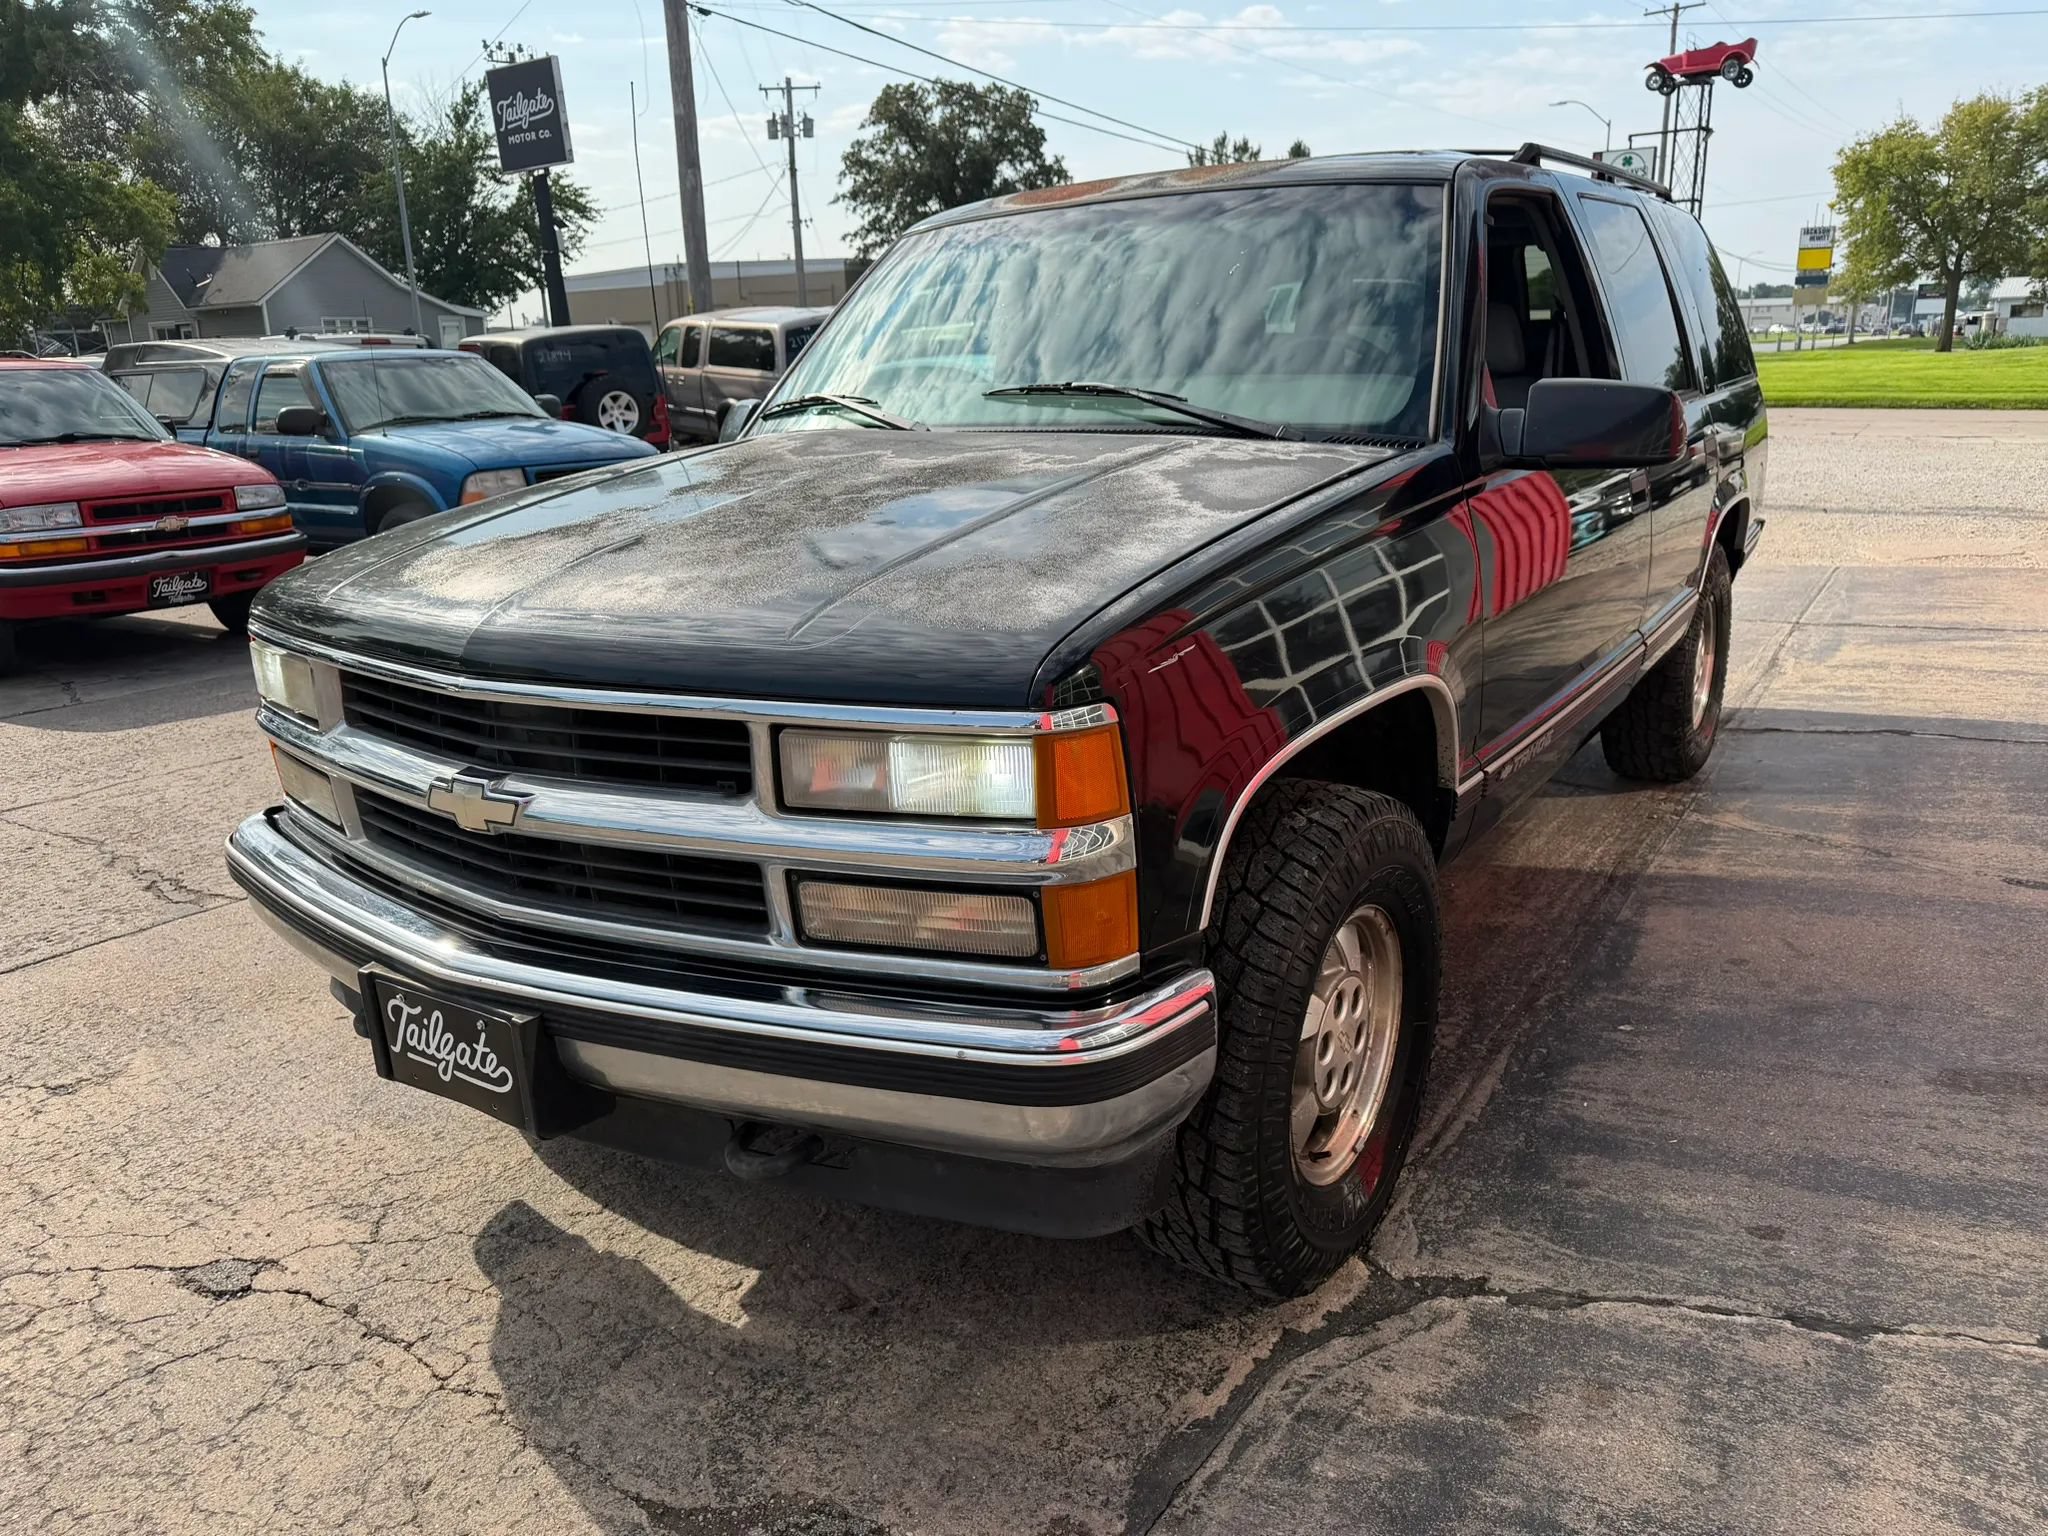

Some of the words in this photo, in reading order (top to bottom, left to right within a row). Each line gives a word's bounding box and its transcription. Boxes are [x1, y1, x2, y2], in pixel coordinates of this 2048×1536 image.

[497, 87, 554, 132] Tailgate
[508, 130, 537, 145] MOTOR
[538, 129, 553, 139] CO.
[153, 571, 207, 598] Tailgate
[387, 998, 513, 1093] Tailgate
